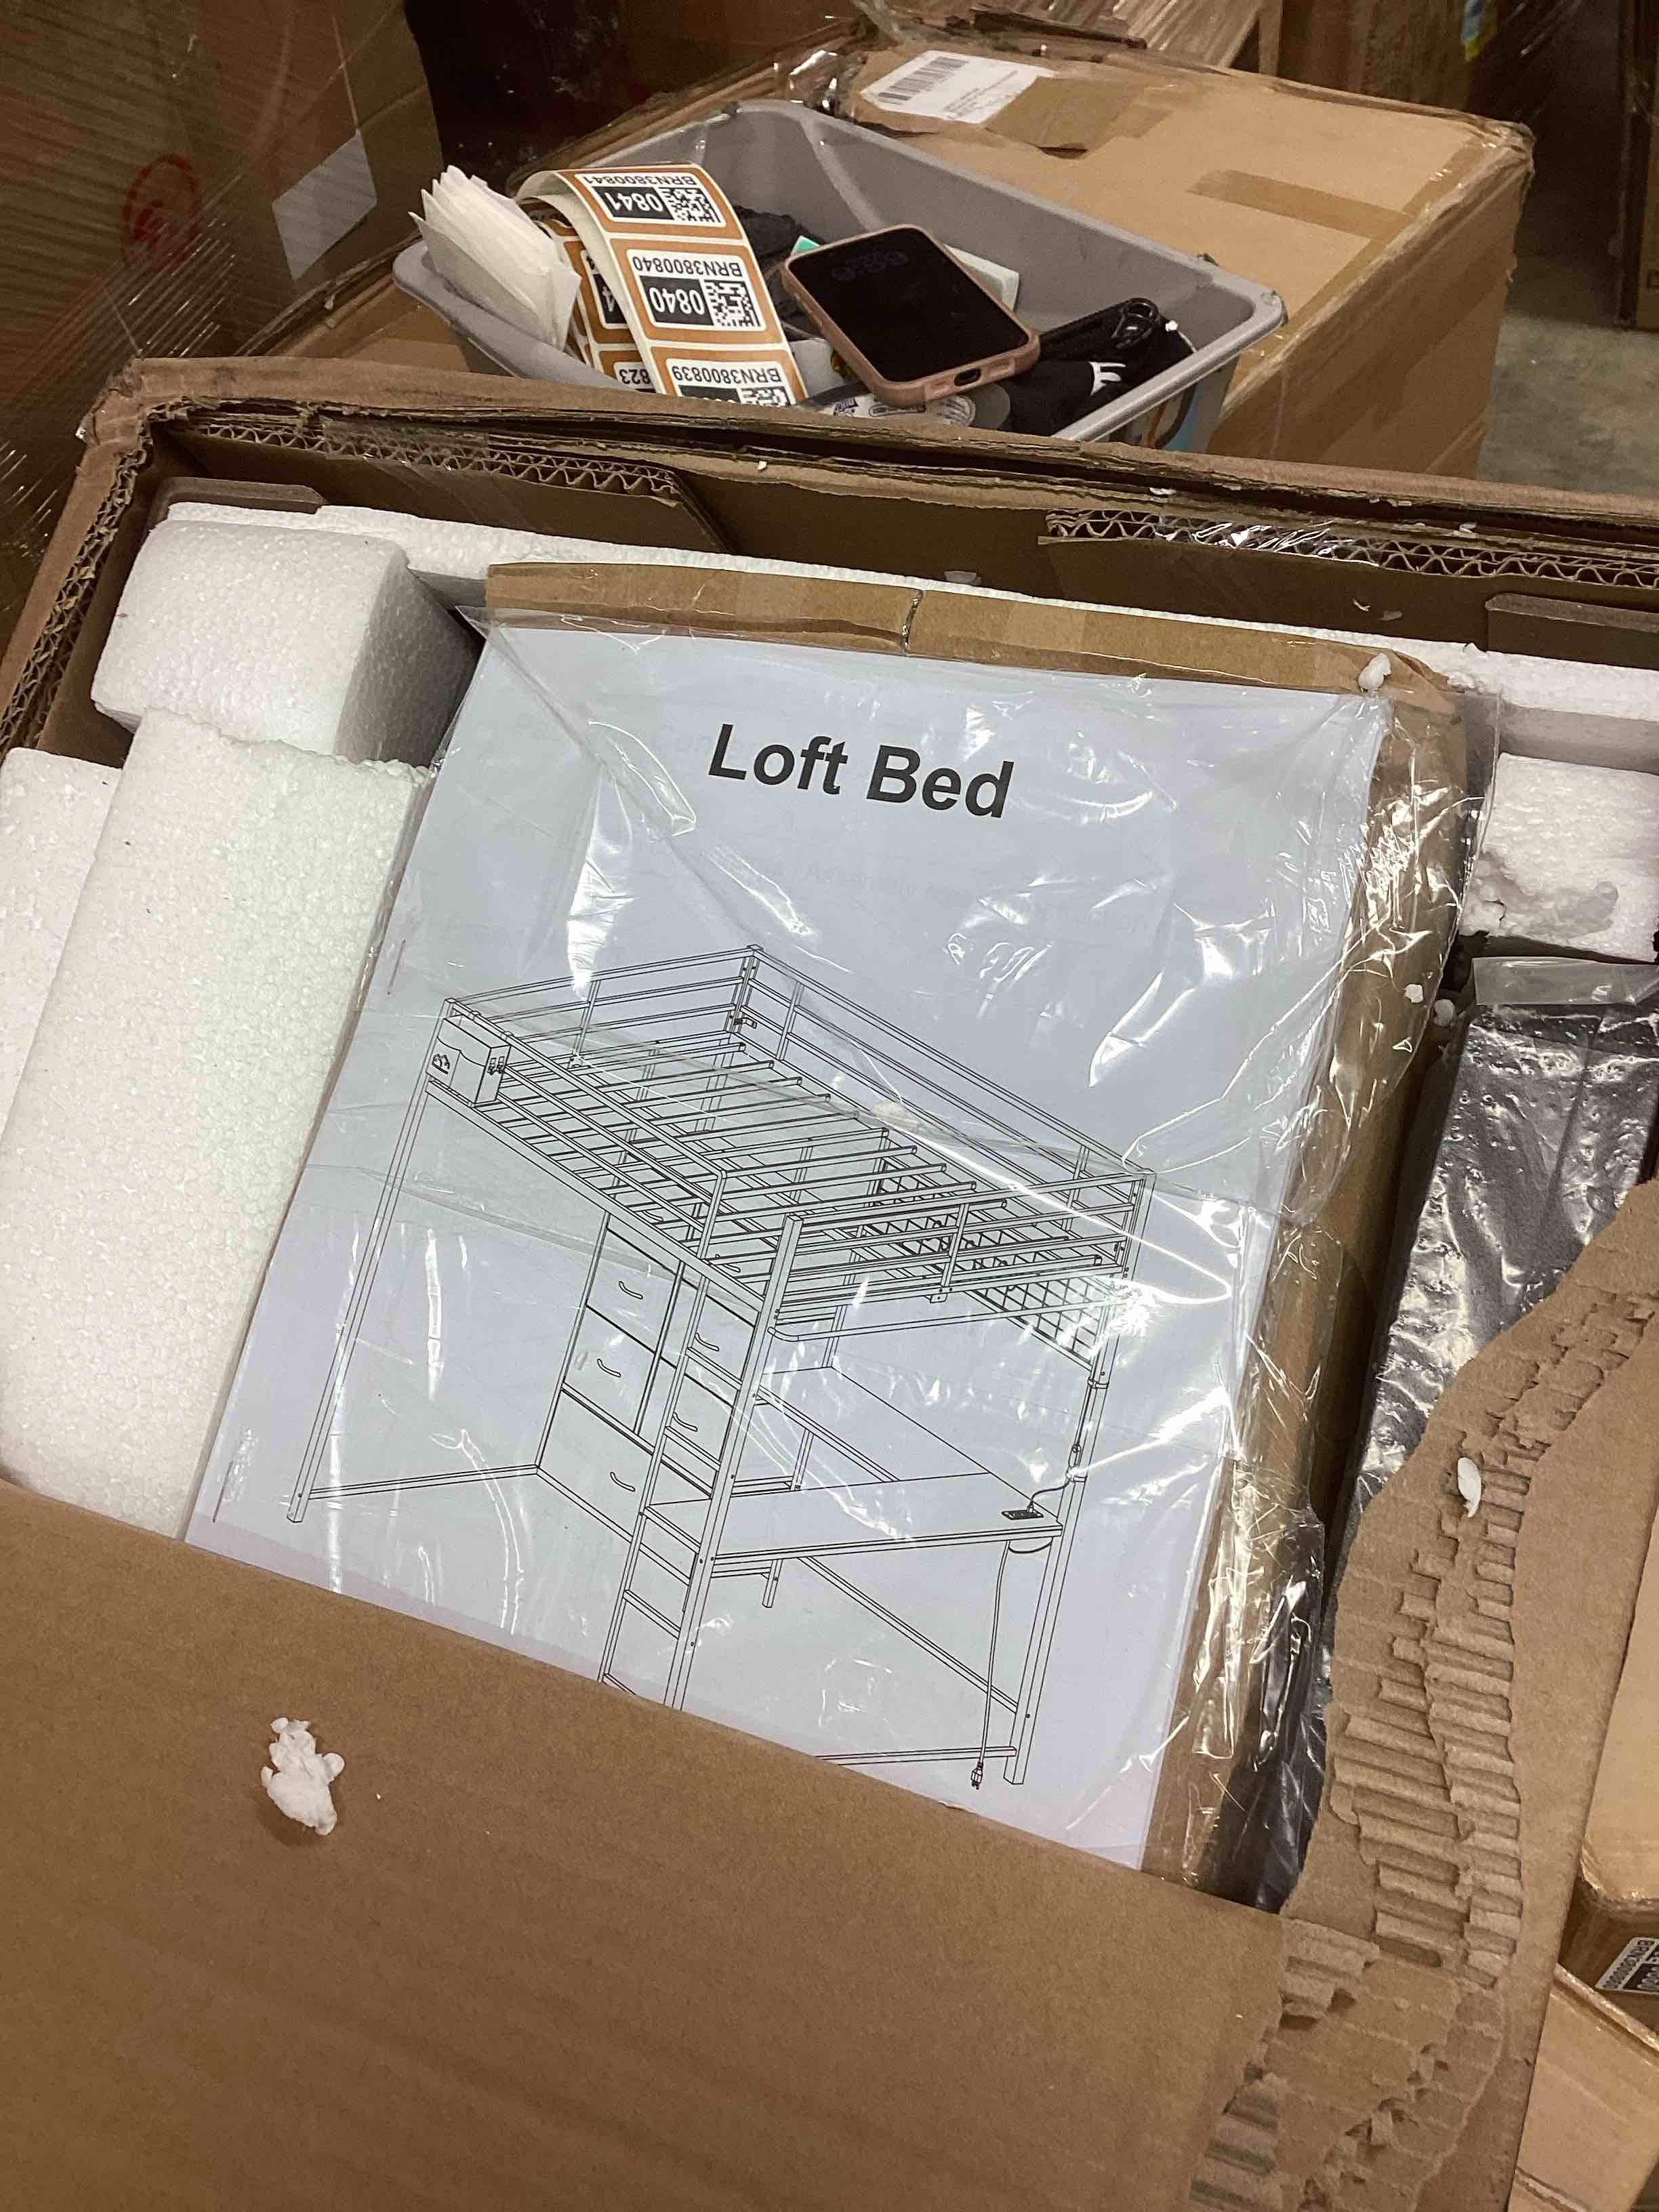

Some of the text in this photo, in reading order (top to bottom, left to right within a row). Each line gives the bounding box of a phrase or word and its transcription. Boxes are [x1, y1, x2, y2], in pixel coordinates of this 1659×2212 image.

[583, 176, 697, 185] BRN3800841
[605, 192, 663, 212] 0841
[632, 256, 743, 277] BRN3800840
[649, 287, 705, 315] 0840
[672, 366, 782, 382] BRN3800839
[708, 723, 1015, 819] Loft Bed
